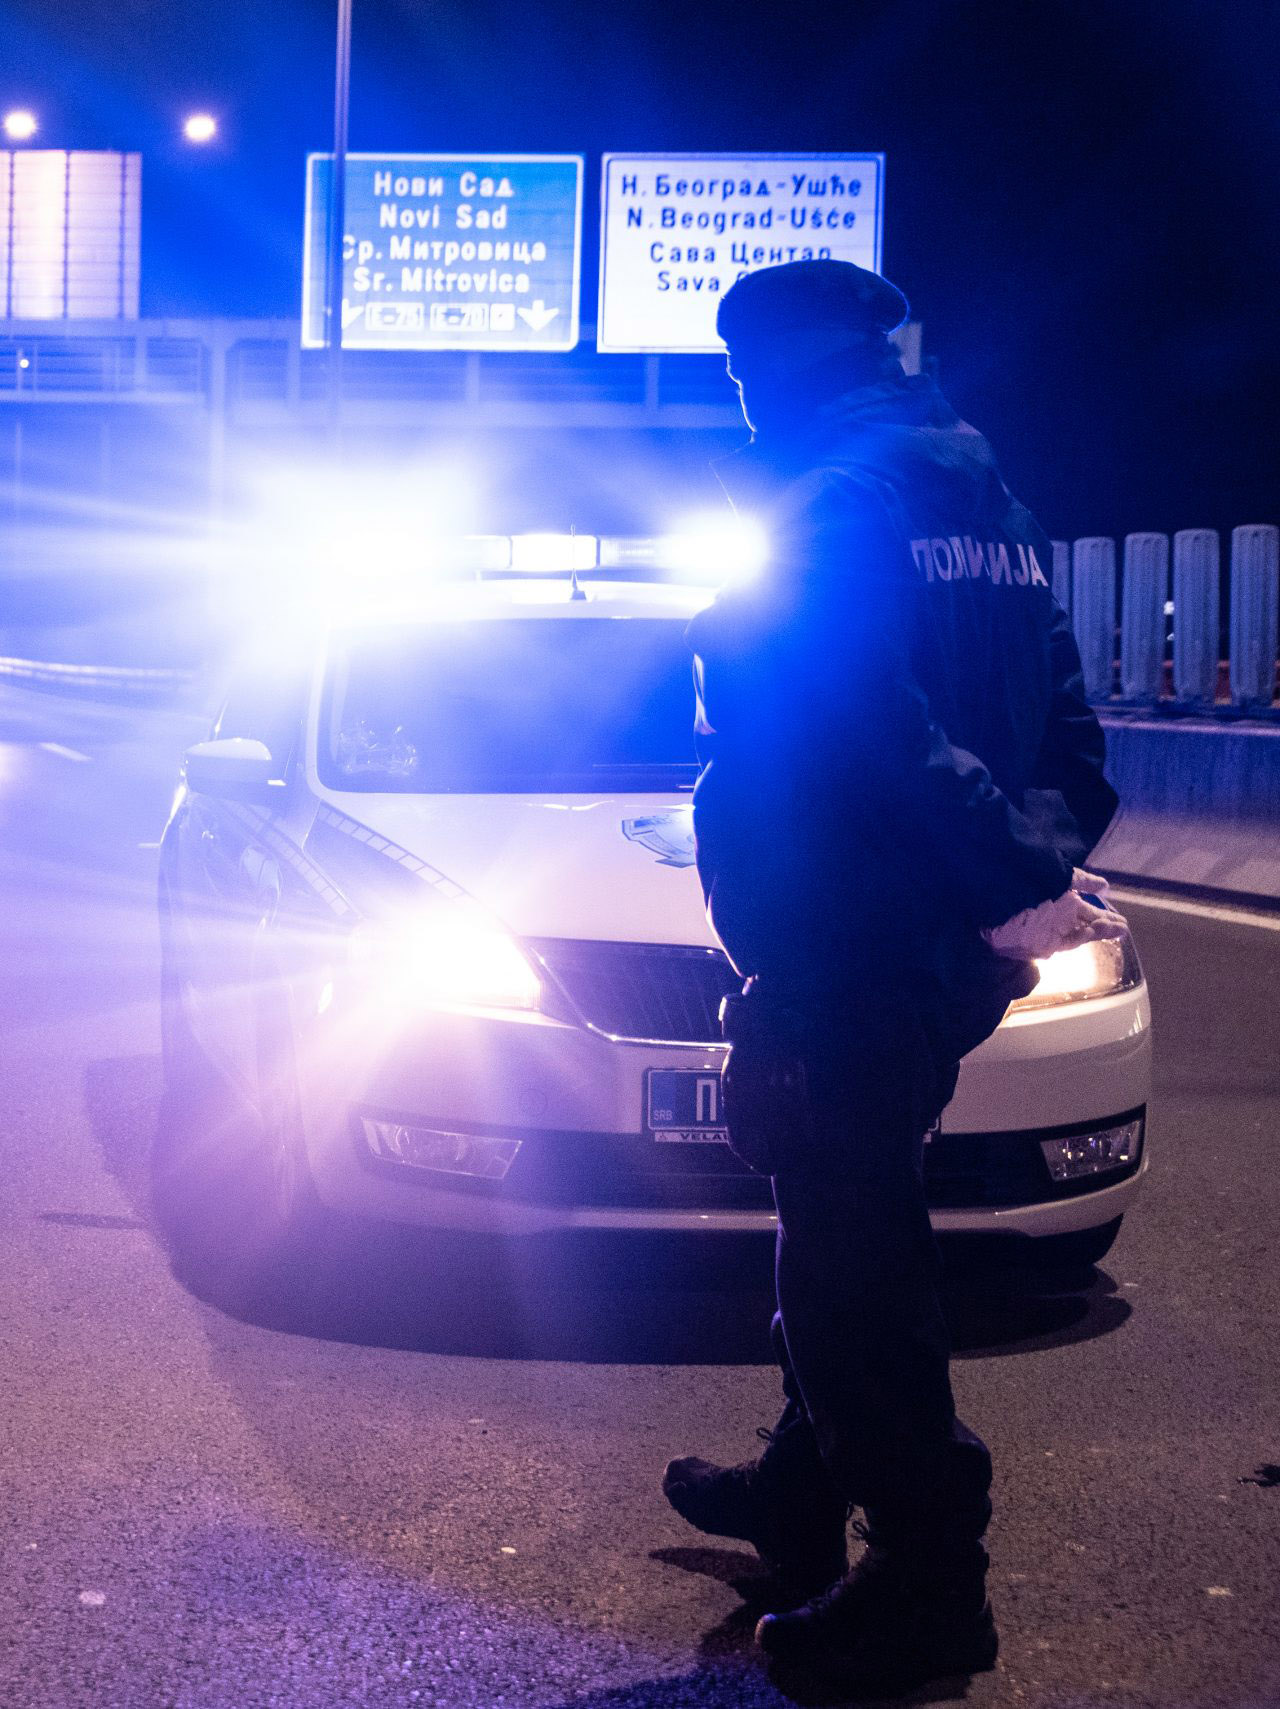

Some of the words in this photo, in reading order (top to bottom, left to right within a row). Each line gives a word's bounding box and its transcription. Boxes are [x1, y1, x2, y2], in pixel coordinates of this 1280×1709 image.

[373, 171, 444, 197] Нови
[459, 171, 515, 198] Сад
[655, 173, 862, 202] Београд-Ушће
[379, 203, 440, 228] Novi
[456, 204, 508, 229] Sad
[389, 235, 547, 266] Митровица
[649, 242, 716, 264] Сава
[353, 266, 394, 292] Sr.
[400, 266, 531, 293] Mitrovica
[657, 271, 720, 292] Sava
[910, 536, 1049, 587] ПОЛИИЈА
[653, 1109, 673, 1121] SRB
